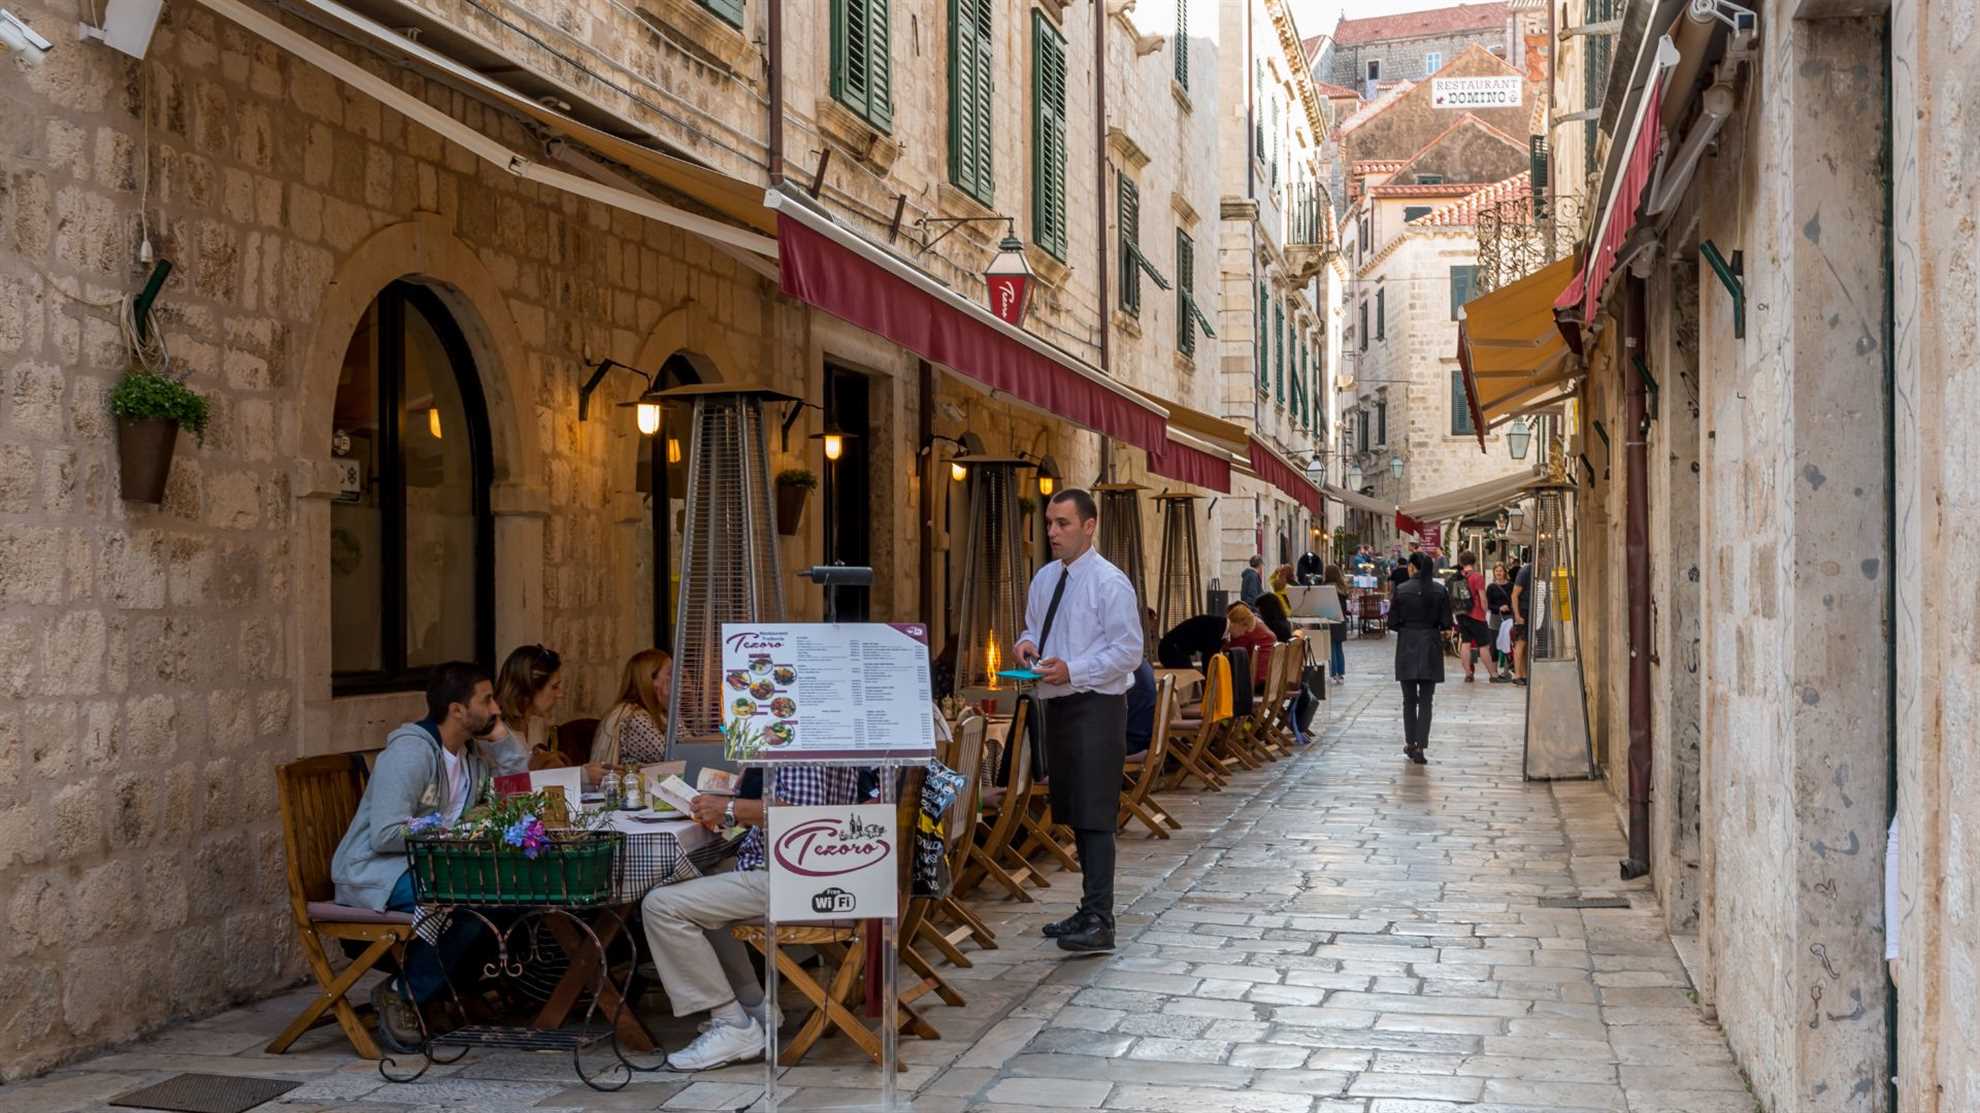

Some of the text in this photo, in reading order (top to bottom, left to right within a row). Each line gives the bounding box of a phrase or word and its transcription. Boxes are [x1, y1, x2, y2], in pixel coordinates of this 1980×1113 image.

[1436, 79, 1518, 91] RESTAURANT
[1448, 91, 1506, 104] DOMINO
[726, 632, 784, 653] Tezoro
[784, 826, 877, 866] Tezoro
